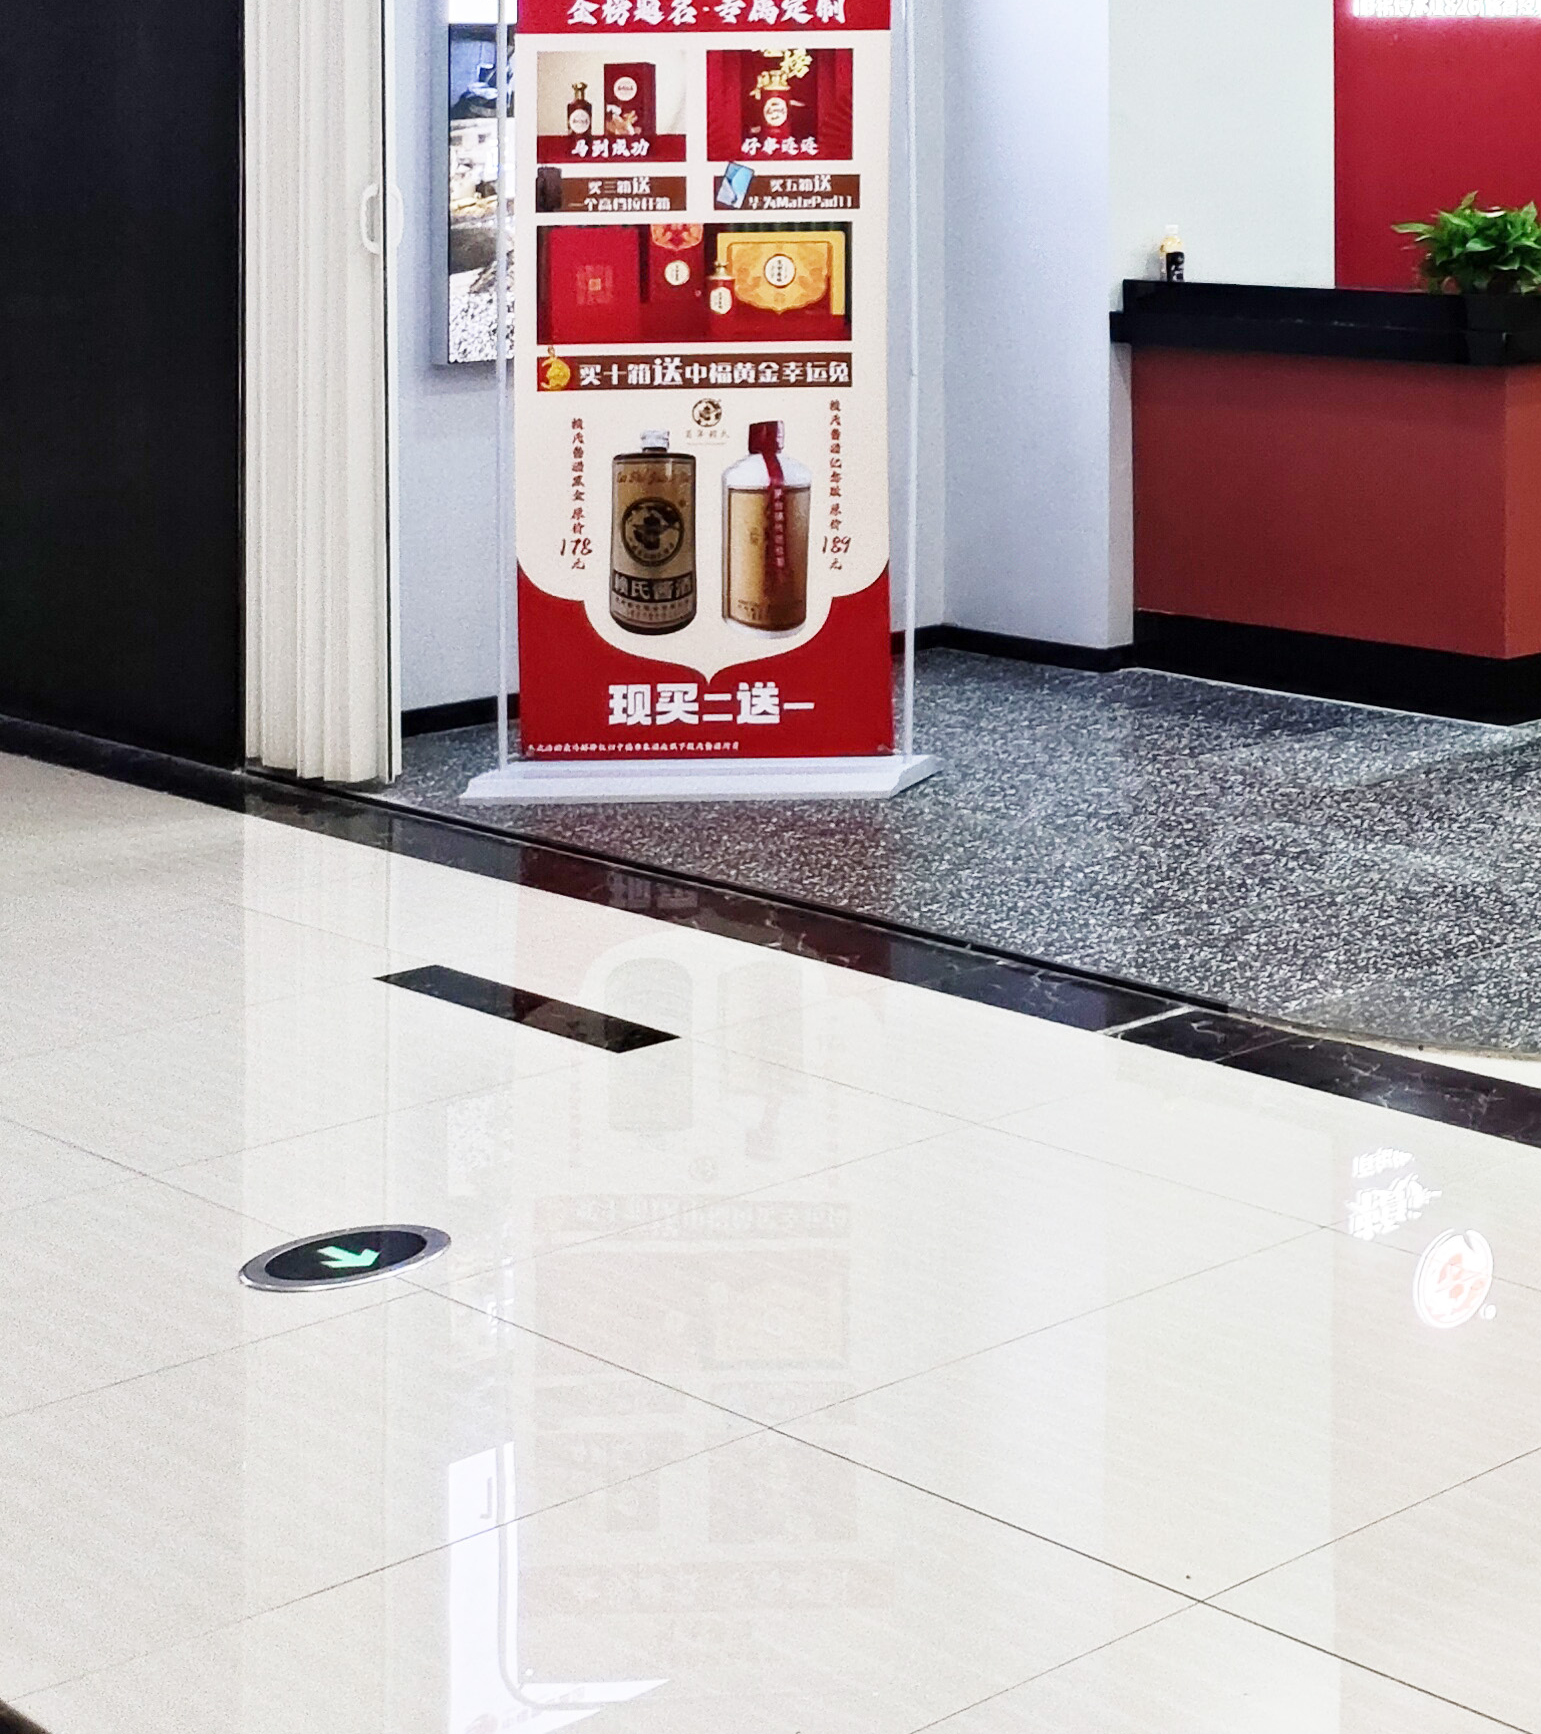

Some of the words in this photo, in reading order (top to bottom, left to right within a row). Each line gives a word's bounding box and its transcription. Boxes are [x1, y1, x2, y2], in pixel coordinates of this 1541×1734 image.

[571, 138, 650, 158] 马到成功
[608, 681, 815, 726] 现买二送一
